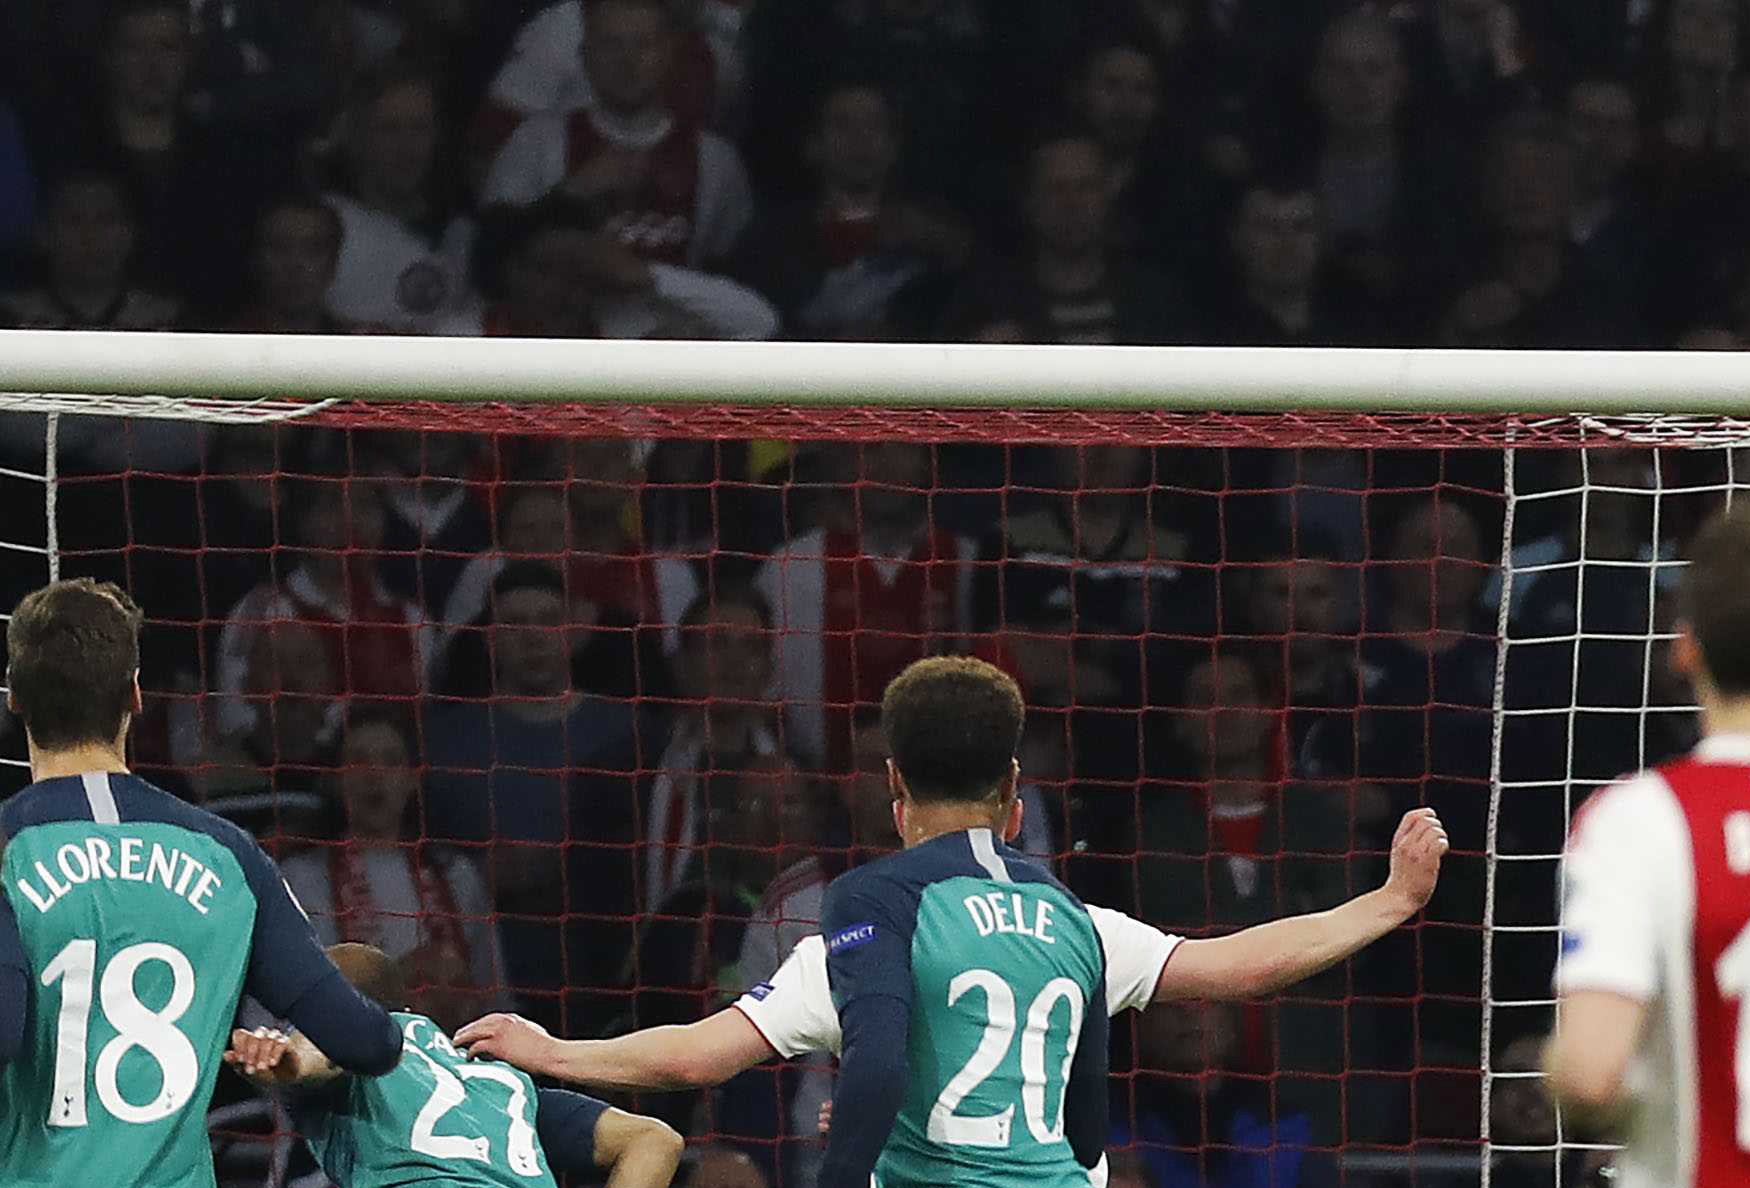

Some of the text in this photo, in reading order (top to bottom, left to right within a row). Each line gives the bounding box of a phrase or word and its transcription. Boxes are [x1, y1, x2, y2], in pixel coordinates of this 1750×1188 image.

[17, 837, 222, 913] LLORENTE
[963, 892, 1056, 944] DELE
[41, 939, 199, 1127] 18
[927, 969, 1084, 1146] 20
[403, 1043, 543, 1177] 27
